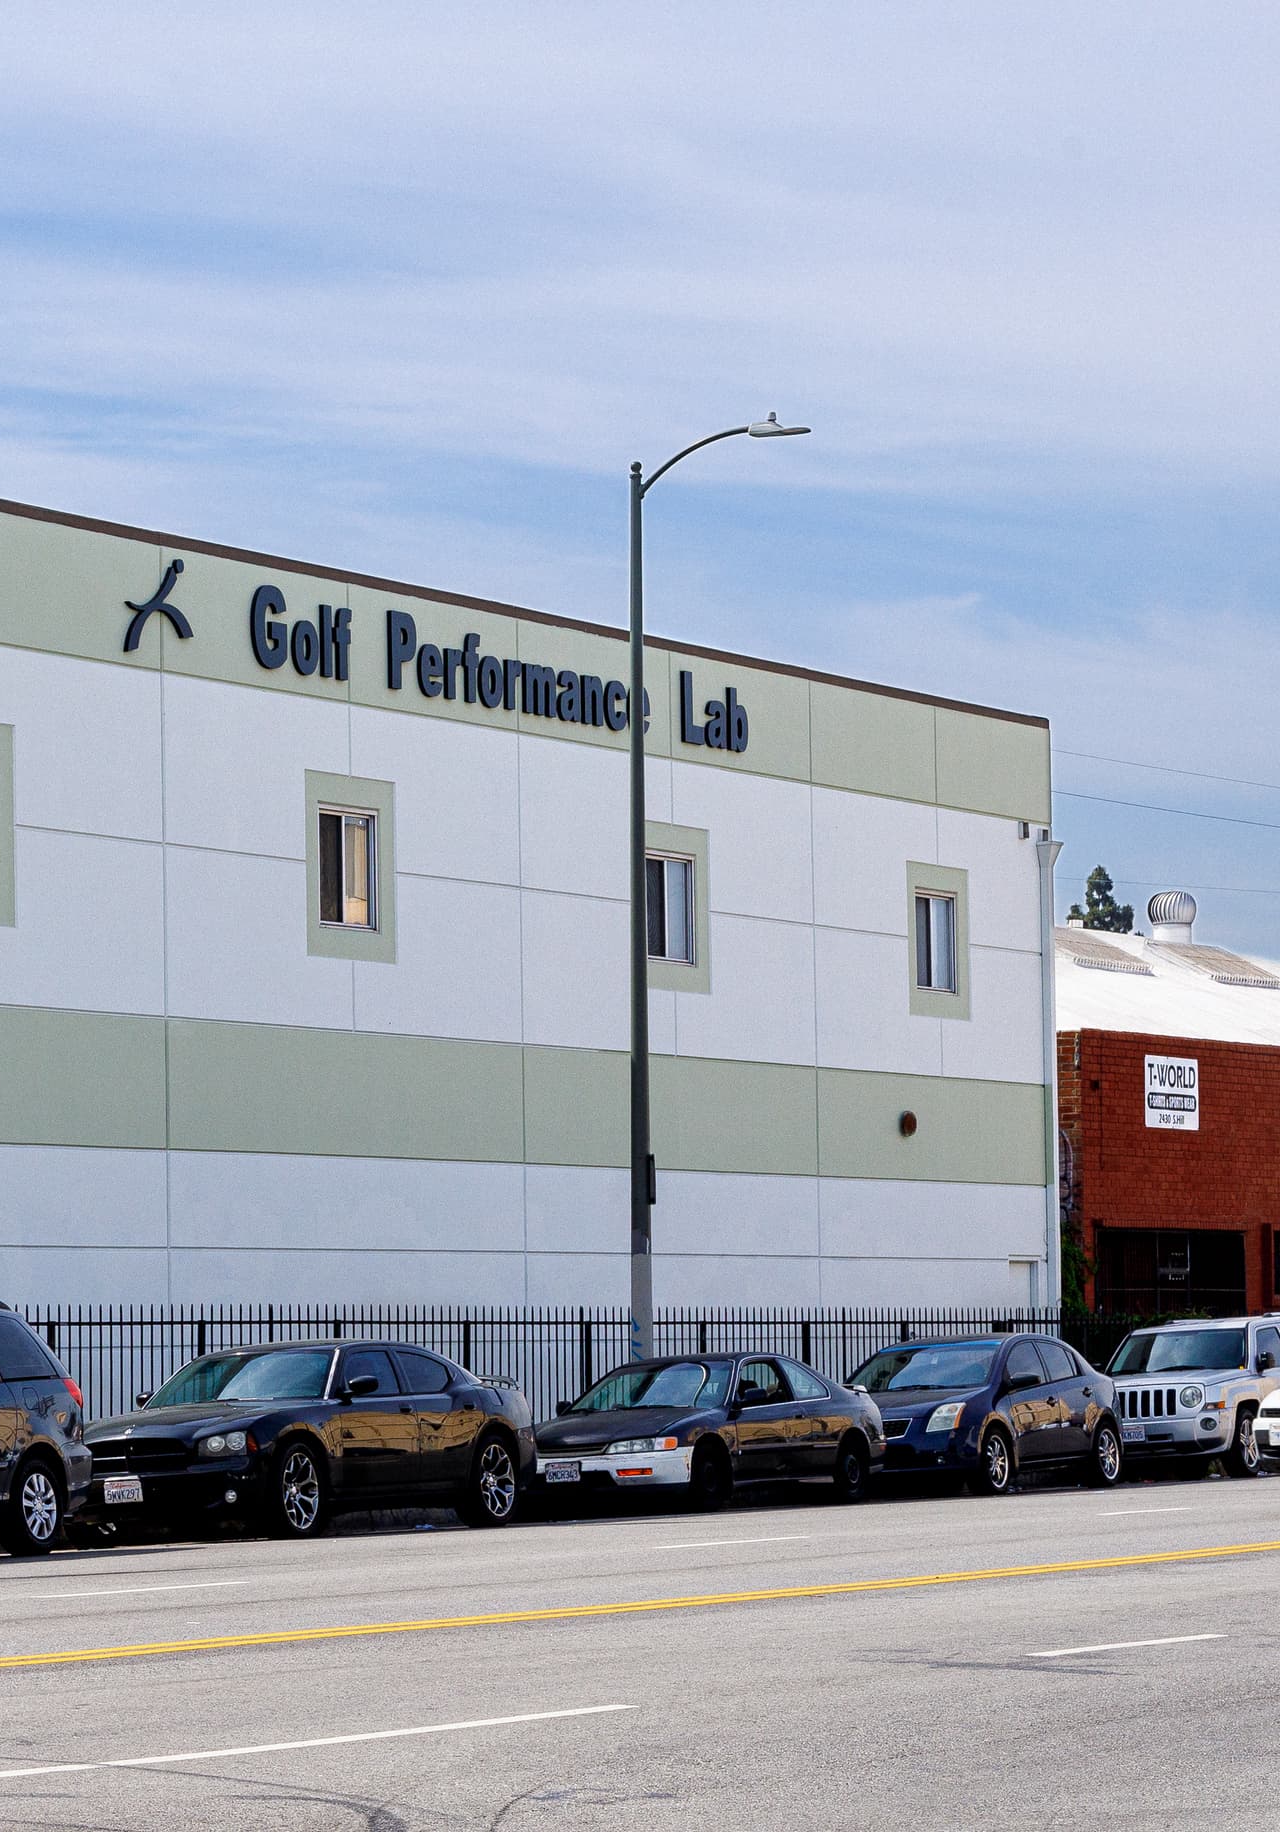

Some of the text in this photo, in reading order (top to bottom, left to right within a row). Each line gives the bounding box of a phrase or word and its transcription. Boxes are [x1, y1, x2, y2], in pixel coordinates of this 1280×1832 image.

[250, 584, 353, 682] Golf
[679, 670, 749, 753] Lab
[1148, 1063, 1195, 1088] T-WORLD
